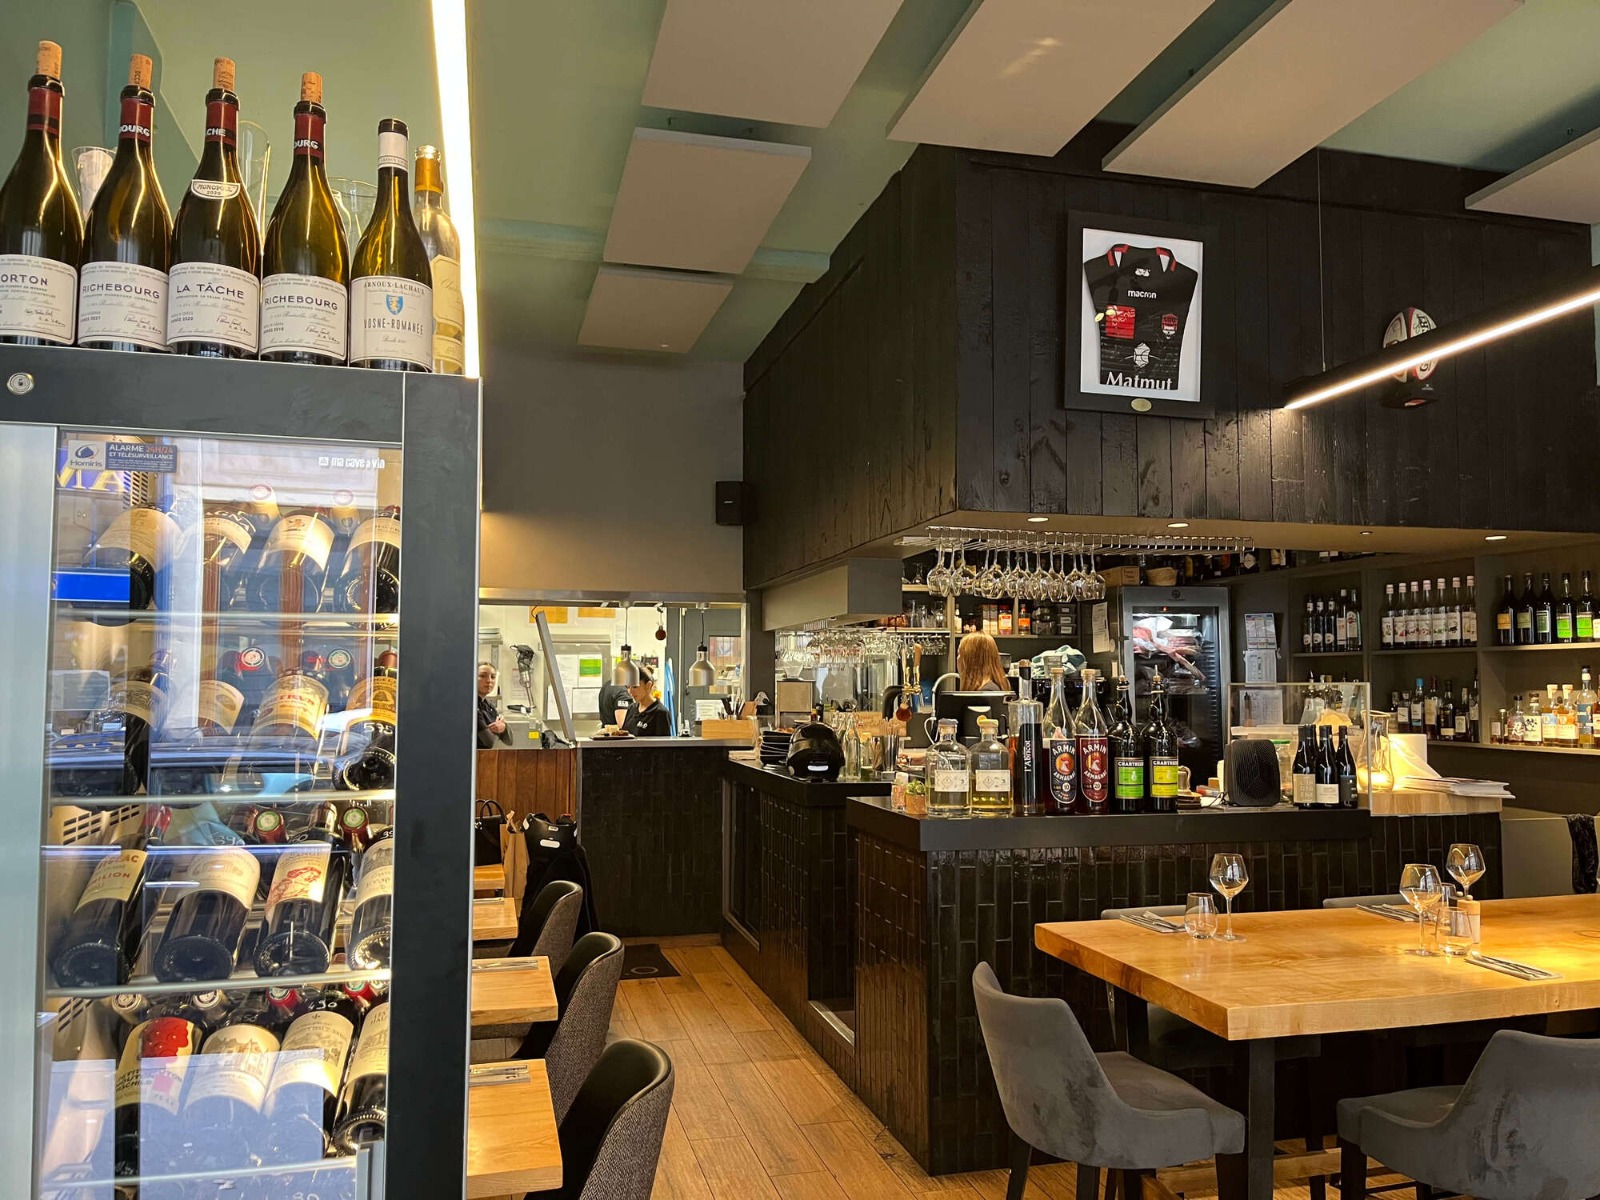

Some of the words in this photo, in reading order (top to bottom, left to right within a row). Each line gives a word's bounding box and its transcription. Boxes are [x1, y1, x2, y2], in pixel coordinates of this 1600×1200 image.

[82, 283, 160, 299] RICHEBOURG
[176, 284, 191, 294] LA
[196, 282, 245, 299] TÂCHE
[1127, 289, 1157, 299] macron
[264, 294, 338, 311] RICHEBOURG
[1106, 371, 1173, 391] Matmut
[109, 444, 144, 453] ALARME
[70, 460, 103, 468] Homiris
[1052, 744, 1076, 755] ARMIN
[1082, 743, 1107, 755] ARMIN
